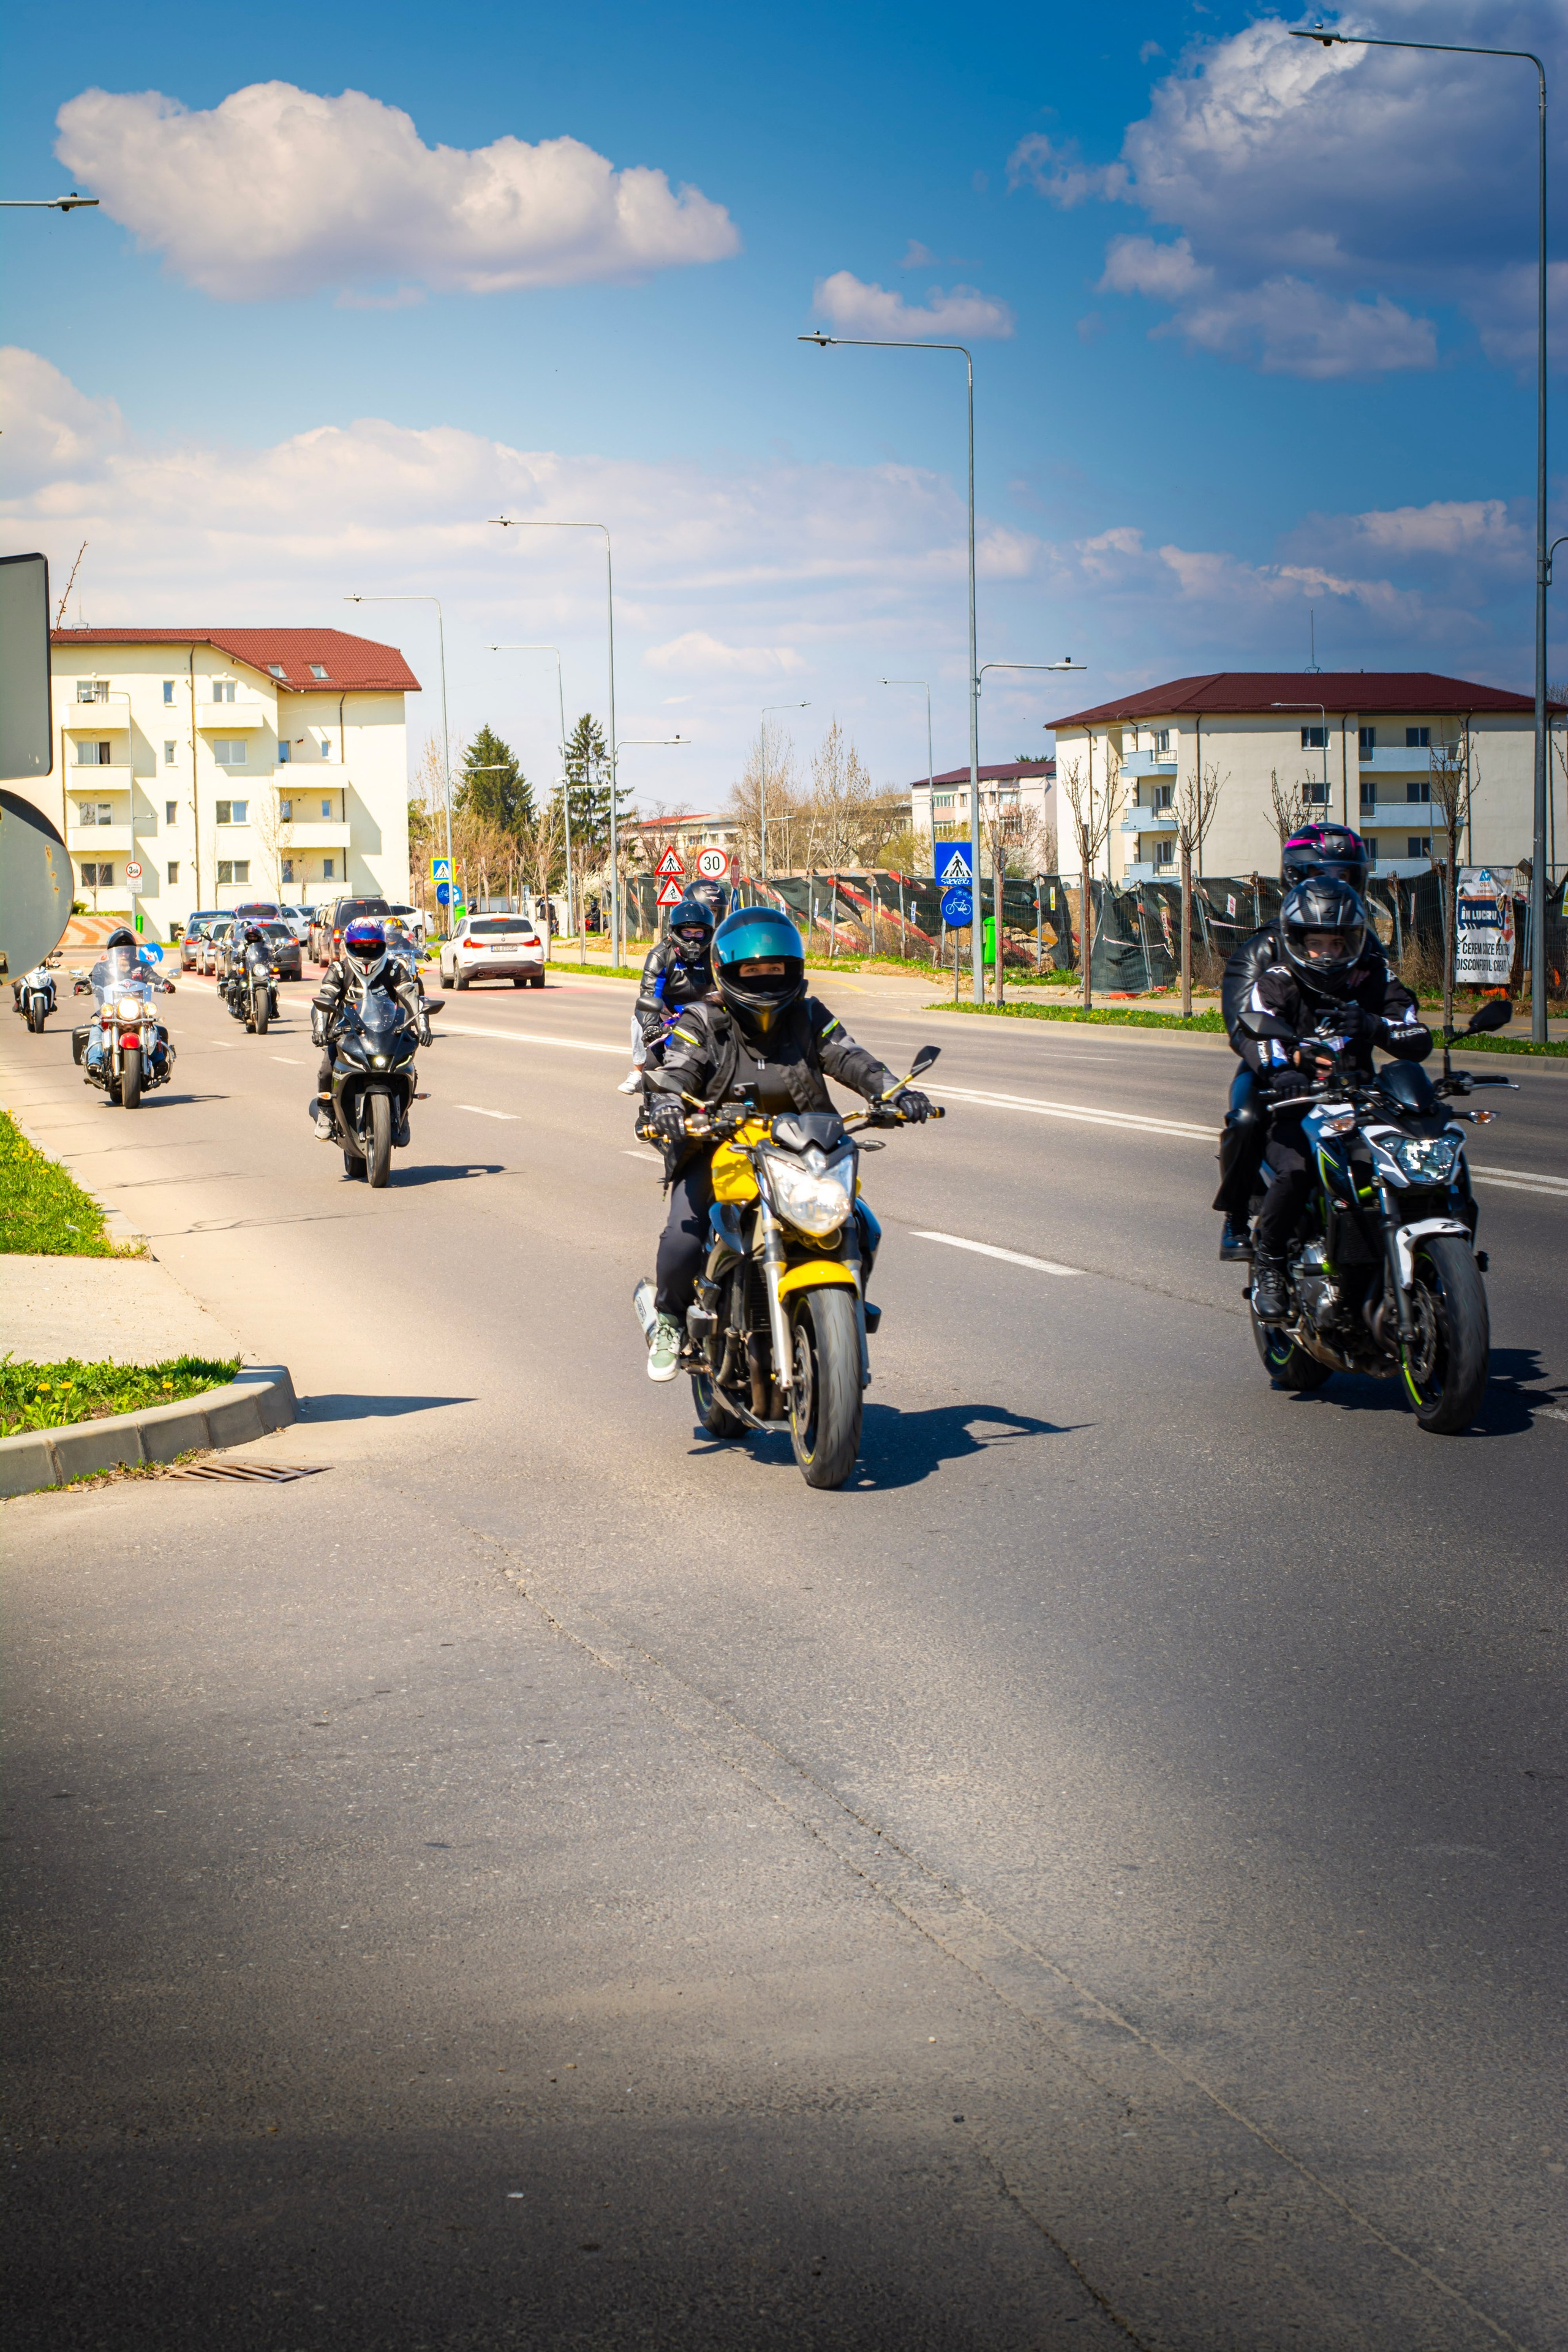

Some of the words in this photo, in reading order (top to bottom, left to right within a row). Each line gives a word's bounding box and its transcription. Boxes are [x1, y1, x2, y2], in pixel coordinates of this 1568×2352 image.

[704, 856, 720, 870] 30
[1461, 906, 1471, 920] ÎN
[1472, 910, 1497, 921] LUCRU
[1462, 943, 1482, 955] CEREM
